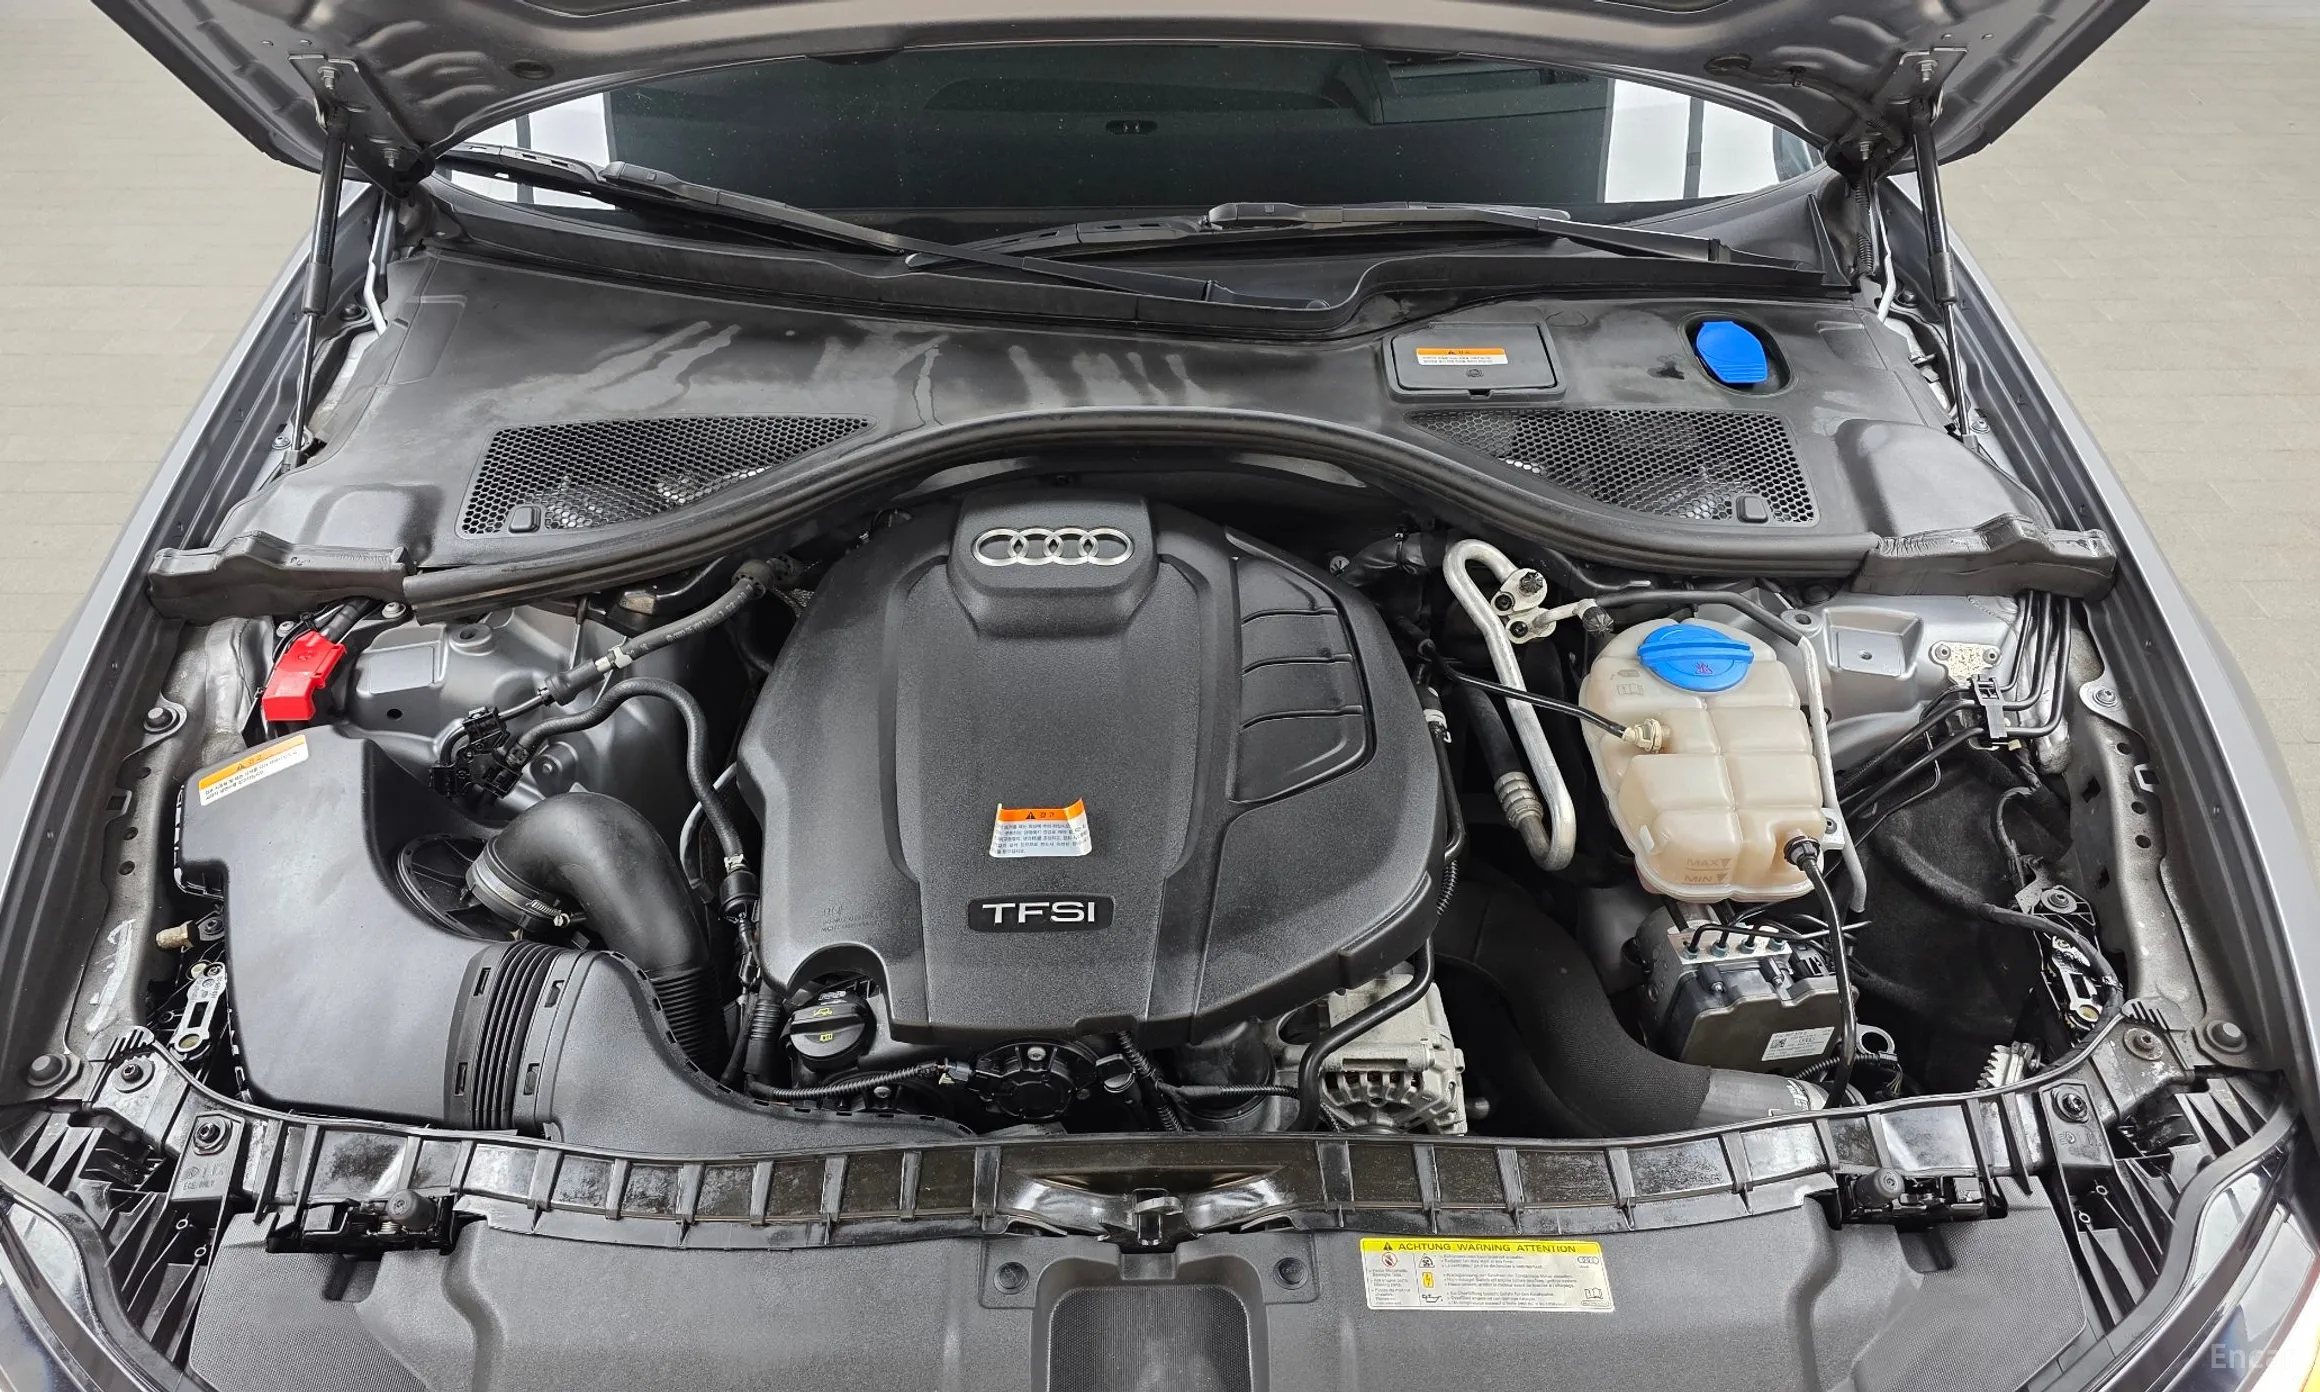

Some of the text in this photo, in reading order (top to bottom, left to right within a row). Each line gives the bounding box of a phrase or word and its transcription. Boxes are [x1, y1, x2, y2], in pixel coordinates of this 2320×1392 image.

[1686, 858, 1719, 867] MAX
[1684, 874, 1713, 883] MIN
[982, 901, 1096, 924] TFSI
[1398, 1242, 1577, 1253] ACHTUNG WARNING ATTENTION
